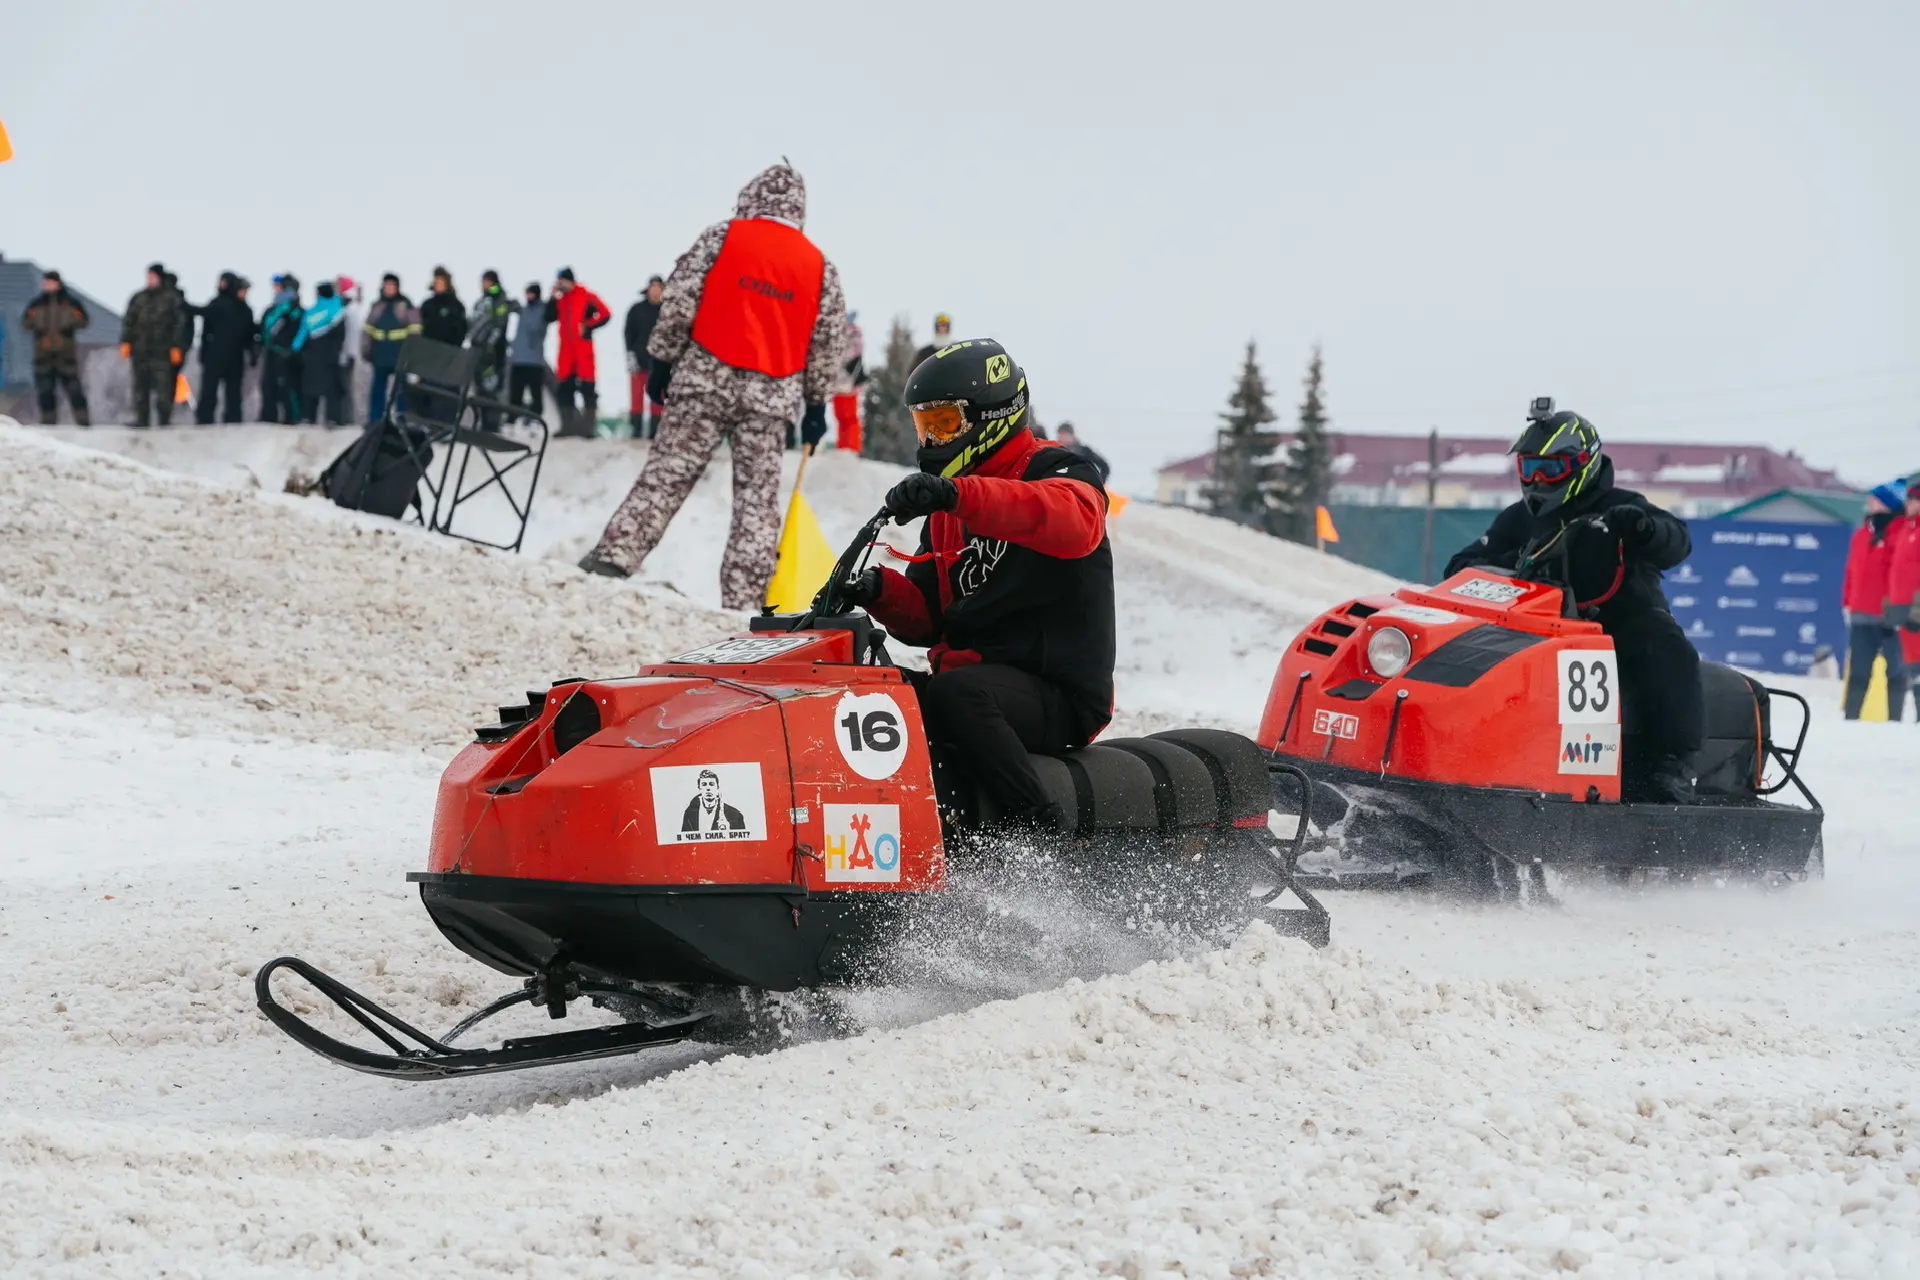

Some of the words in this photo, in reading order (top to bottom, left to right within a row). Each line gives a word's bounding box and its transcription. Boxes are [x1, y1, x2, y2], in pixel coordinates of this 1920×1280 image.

[981, 403, 1019, 420] Helios
[1568, 660, 1609, 713] 83
[841, 710, 901, 752] 16
[1314, 710, 1358, 738] 640
[729, 831, 751, 839] БРАТ?
